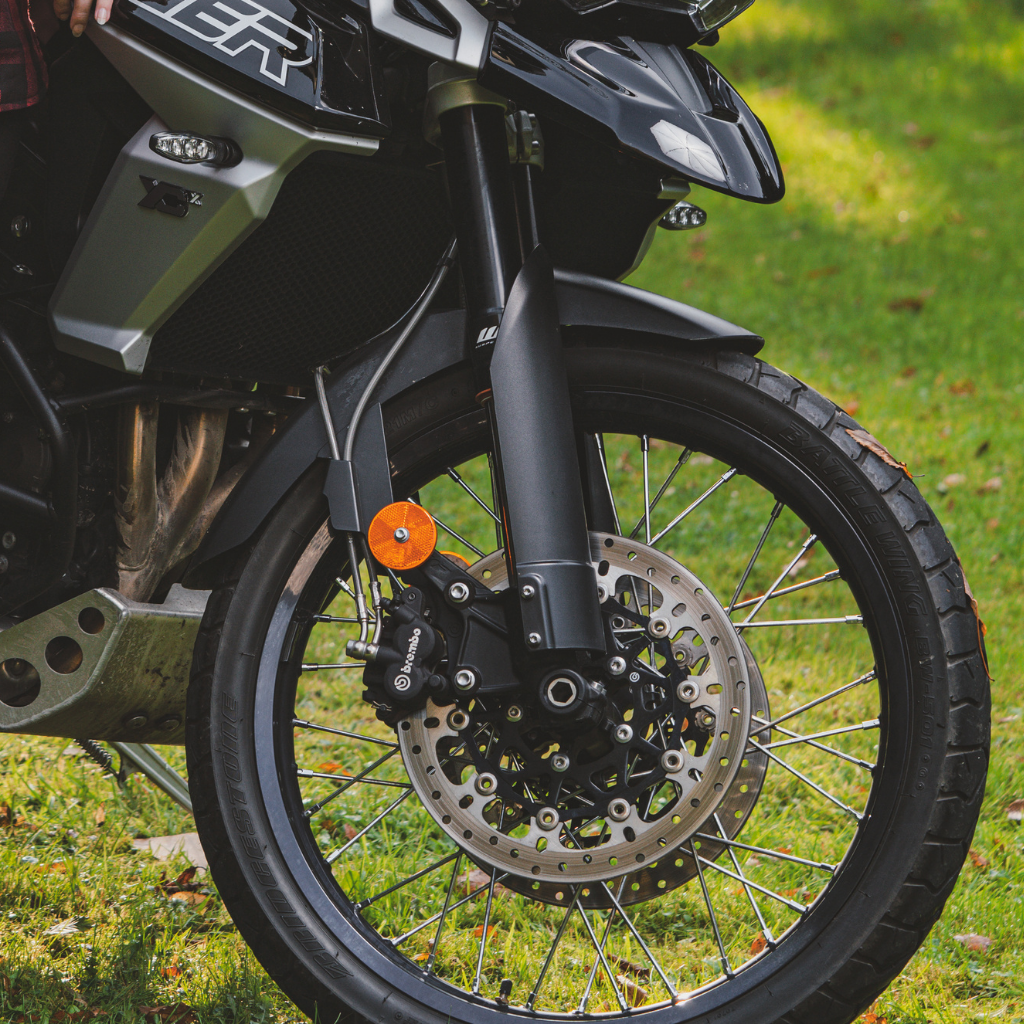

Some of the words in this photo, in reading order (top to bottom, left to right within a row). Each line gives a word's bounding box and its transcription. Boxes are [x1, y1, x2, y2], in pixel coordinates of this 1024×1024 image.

[779, 420, 888, 527] BATTLE
[875, 531, 928, 617] WING
[399, 626, 423, 675] brembo
[221, 690, 354, 980] BRIDGESTONE
